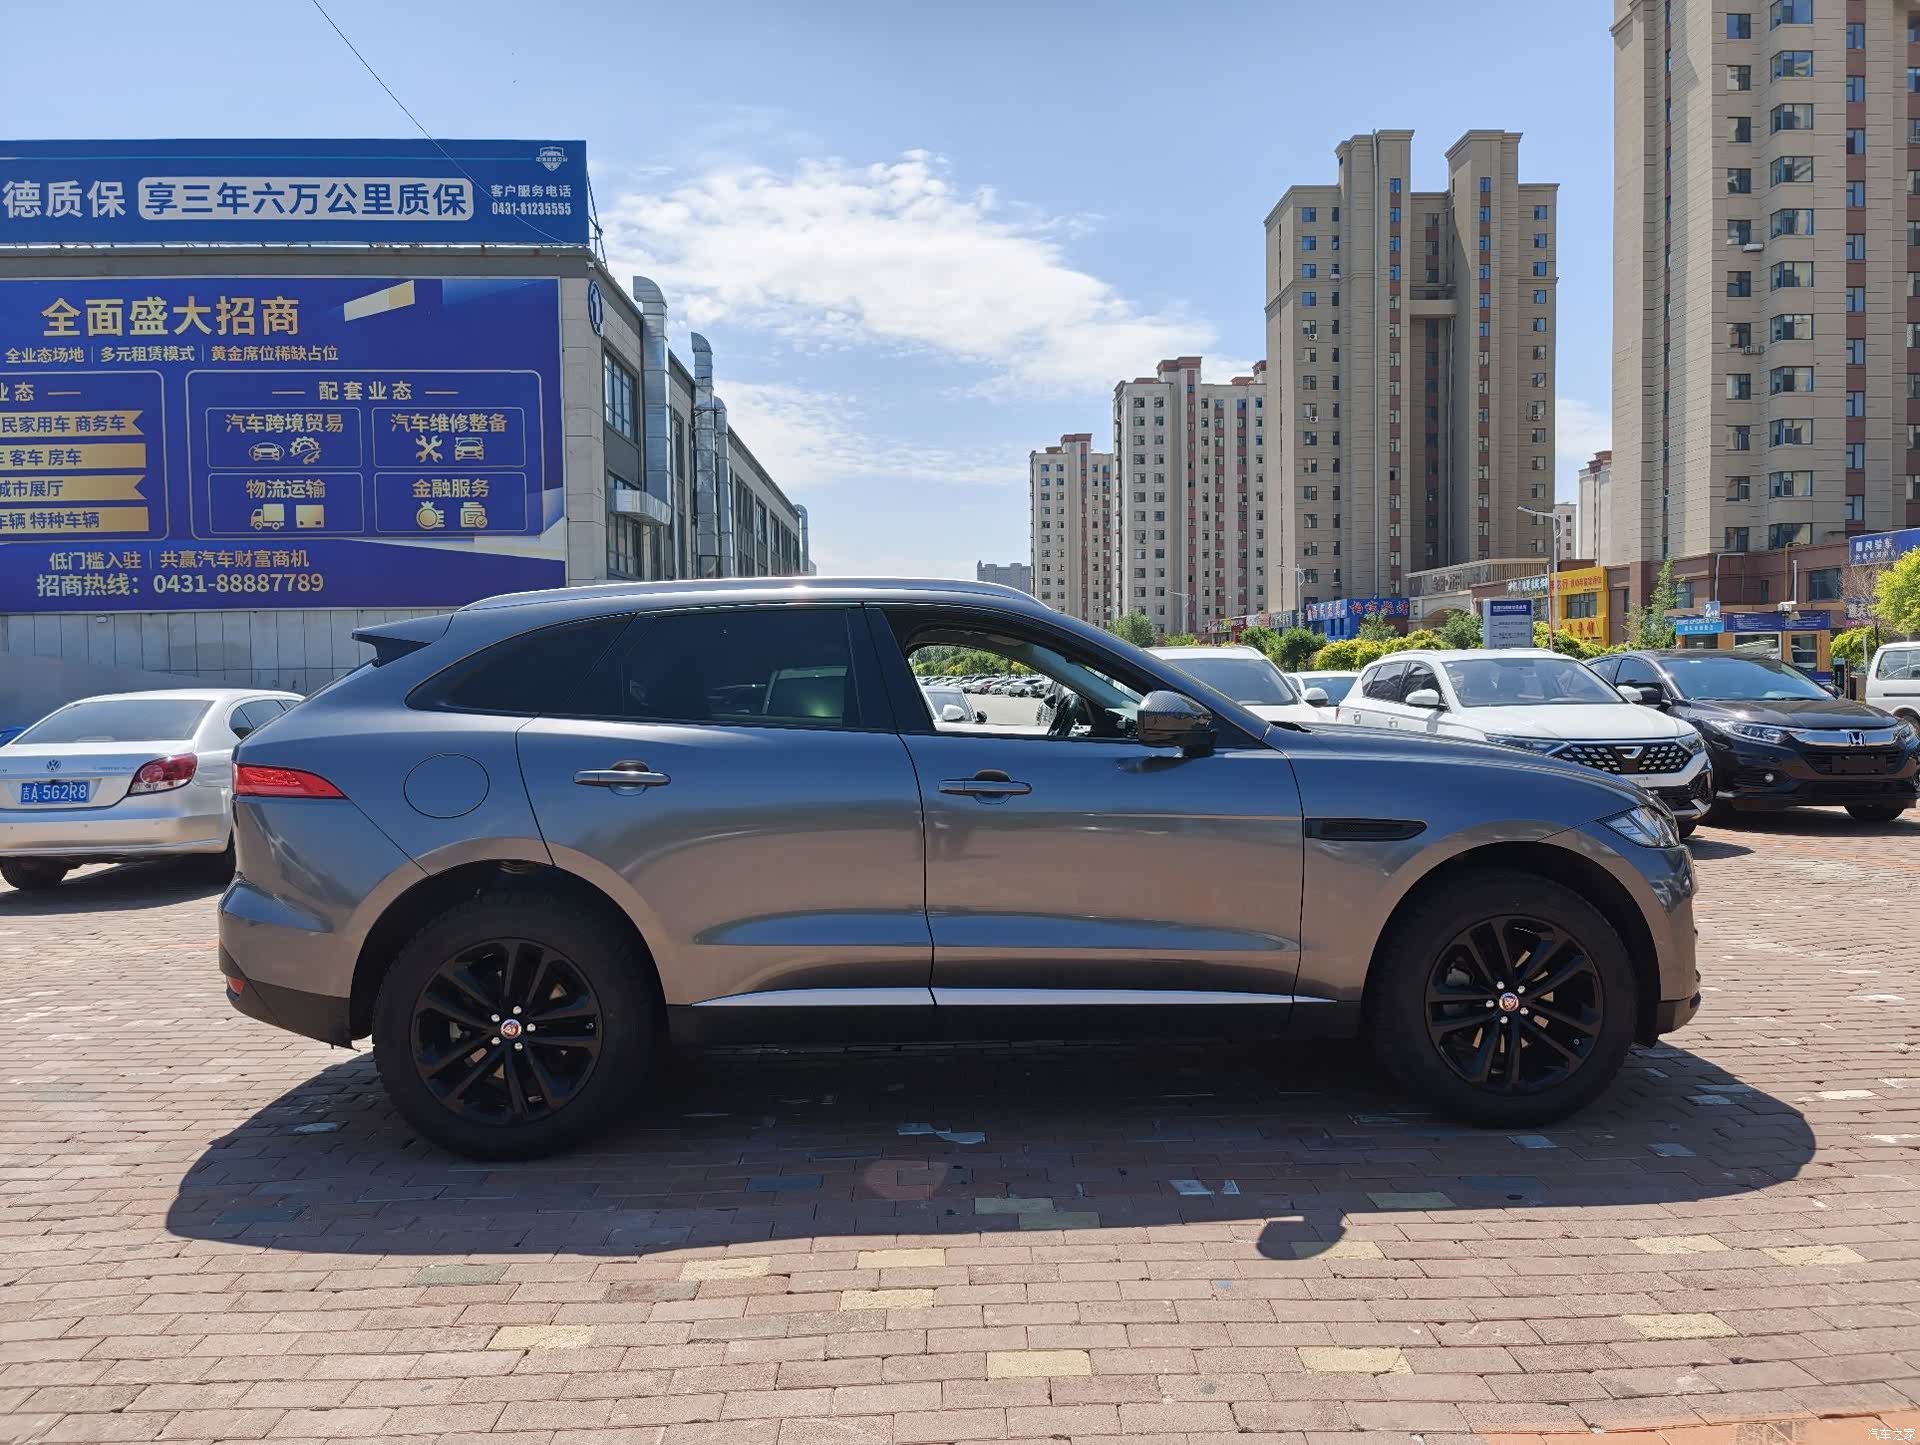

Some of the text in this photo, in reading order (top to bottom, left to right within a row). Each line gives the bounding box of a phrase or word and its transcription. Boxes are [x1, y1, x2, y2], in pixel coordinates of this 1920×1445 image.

[2, 180, 468, 218] 德质保 享三年六万公里质保
[490, 184, 572, 198] 客户服务电话
[492, 202, 572, 215] 0431-81235555
[41, 296, 299, 337] 全面盛大招商
[5, 345, 339, 364] 全业态场地 多元租赁模式 黄金席位稀缺占位
[318, 381, 412, 400] 配套业态
[75, 414, 126, 432] 商务车
[225, 413, 344, 433] 汽车跨境贸易
[390, 413, 507, 433] 汽车维修整备
[9, 449, 44, 467] 客车
[47, 448, 83, 466] 房车
[246, 479, 326, 499] 物流运输
[412, 479, 490, 499] 金融服务
[29, 511, 100, 529] 特种车辆
[49, 549, 310, 571] 低门槛入驻 共赢汽车财富商机
